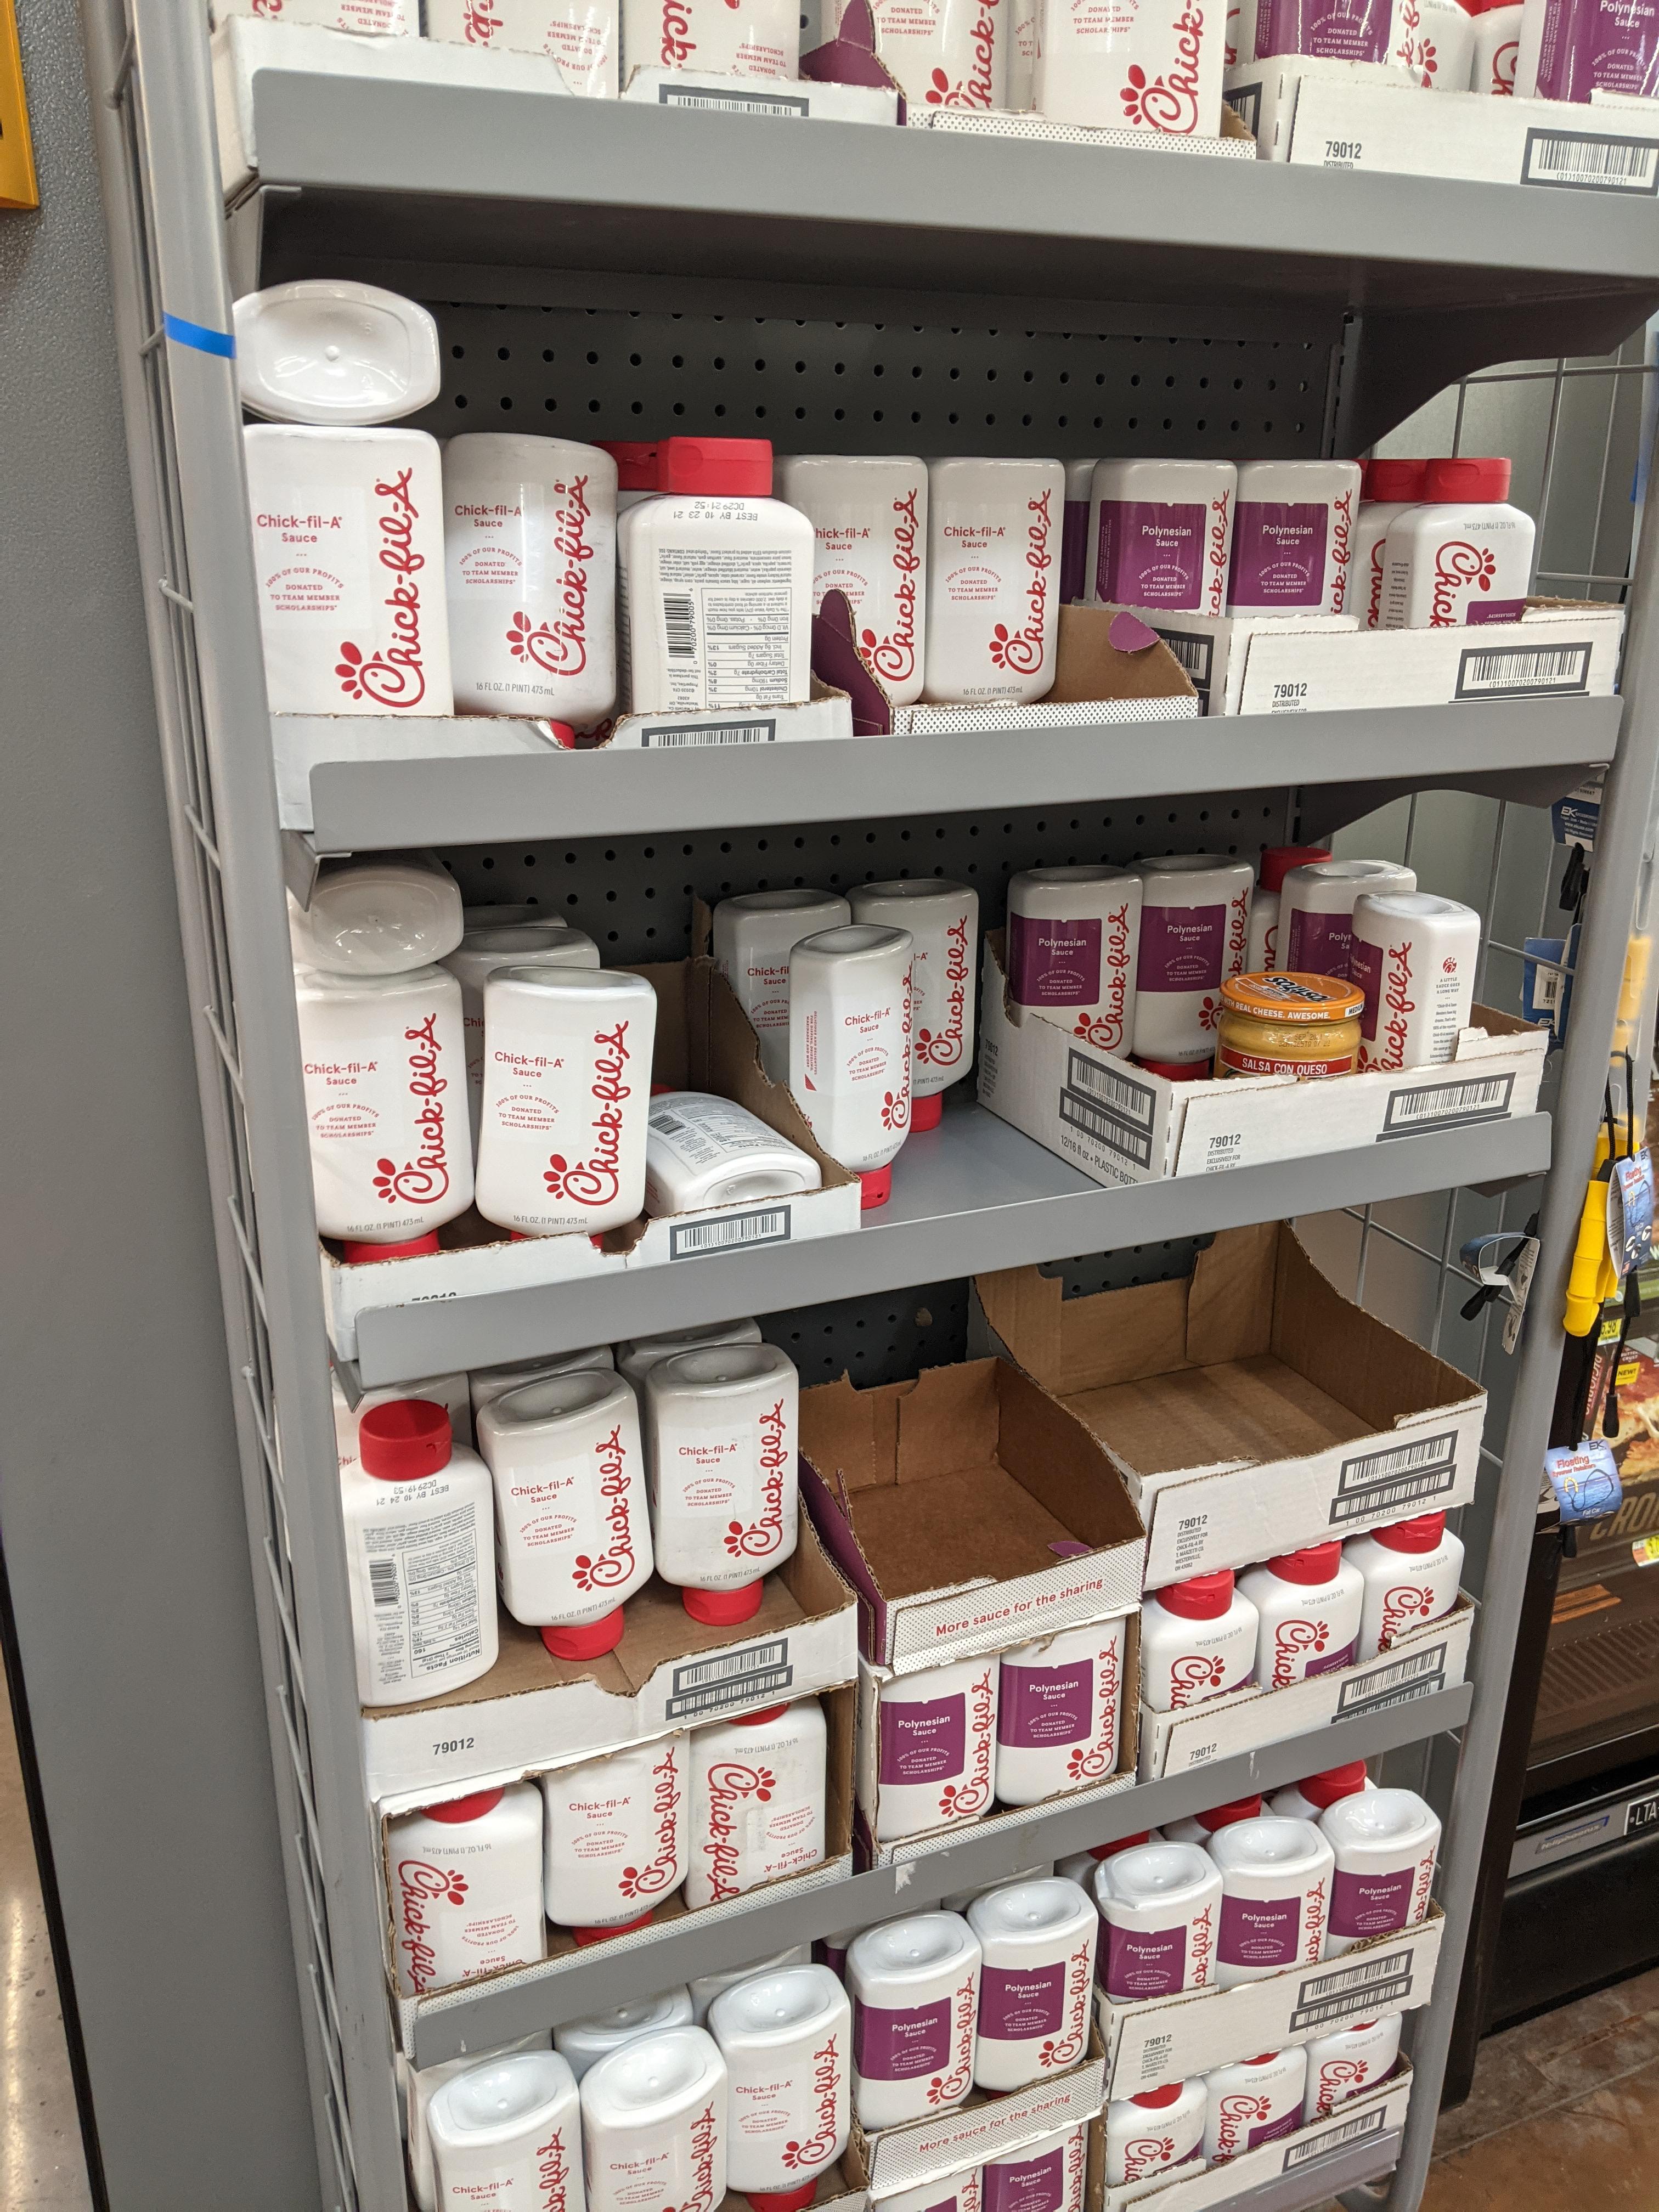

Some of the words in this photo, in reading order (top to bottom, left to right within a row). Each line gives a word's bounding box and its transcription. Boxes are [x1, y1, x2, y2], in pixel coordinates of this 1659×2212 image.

[1600, 1, 1655, 17] Polynesian
[1615, 17, 1640, 28] Sauce
[1328, 28, 1357, 36] DONATED
[1325, 140, 1362, 159] 79012
[473, 518, 503, 528] Sauce
[736, 513, 758, 521] BEST
[814, 527, 871, 539] hick-fil-A
[1142, 525, 1192, 538] Polynesian
[1262, 524, 1313, 537] Polynesian
[281, 533, 318, 543] Sauce
[1155, 539, 1178, 547] Sauce
[1276, 537, 1300, 545] Sauce
[312, 568, 345, 589] PROFITS
[1273, 682, 1307, 698] 79012
[1272, 699, 1300, 708] DISTRIBUTED
[1167, 924, 1212, 934] Polynesian
[1038, 938, 1086, 947] Polynesian
[1235, 1003, 1251, 1013] REAL
[1252, 1007, 1285, 1018] CHEESE.
[860, 1024, 879, 1034] Sauce
[512, 1068, 542, 1077] Sauce
[1242, 1058, 1271, 1071] SALSA
[1274, 1063, 1294, 1074] CON
[1297, 1064, 1327, 1075] QUESO
[326, 1077, 357, 1085] Sauce
[1209, 1134, 1241, 1149] 79012
[1060, 1135, 1077, 1153] 12/16
[1094, 1155, 1118, 1180] PLASTIC
[1207, 1148, 1234, 1156] DISTRIBUTED
[548, 1216, 565, 1225] PINT)
[1557, 1455, 1589, 1469] Floating
[531, 1493, 557, 1503] Sauce
[1371, 1507, 1396, 1519] 70200
[1402, 1499, 1426, 1511] 79012
[1179, 1515, 1207, 1530] 79012
[935, 1620, 969, 1638] More
[973, 1611, 1010, 1628] sauce
[1013, 1600, 1031, 1612] for
[1034, 1593, 1057, 1608] the
[1059, 1578, 1104, 1604] sharing
[449, 1649, 480, 1663] Nutrition
[426, 1662, 447, 1671] Facts
[1029, 1680, 1079, 1693] Polynesian
[898, 1716, 950, 1730] Polynesian
[912, 1728, 936, 1736] Sauce
[433, 1737, 475, 1756] 79012
[1189, 1742, 1217, 1761] 79012
[586, 1811, 613, 1820] Sauce
[1359, 1883, 1402, 1896] Polynesian
[1242, 1913, 1288, 1923] Polynesian
[1126, 1943, 1173, 1955] Polynesian
[1005, 1980, 1052, 1992] Polynesian
[891, 2017, 938, 2033] Polynesian
[904, 2029, 926, 2038] Sauce
[1144, 2034, 1172, 2048] 79012
[752, 2092, 776, 2101] Sauce
[919, 2139, 950, 2153] More
[952, 2124, 987, 2142] sauce
[989, 2117, 1006, 2129] for
[1008, 2109, 1028, 2121] the
[1030, 2094, 1071, 2114] sharing
[627, 2165, 652, 2176] Sauce
[1009, 2166, 1052, 2183] Polynesian
[1022, 2177, 1041, 2187] Sauce
[470, 2191, 496, 2200] Sauce
